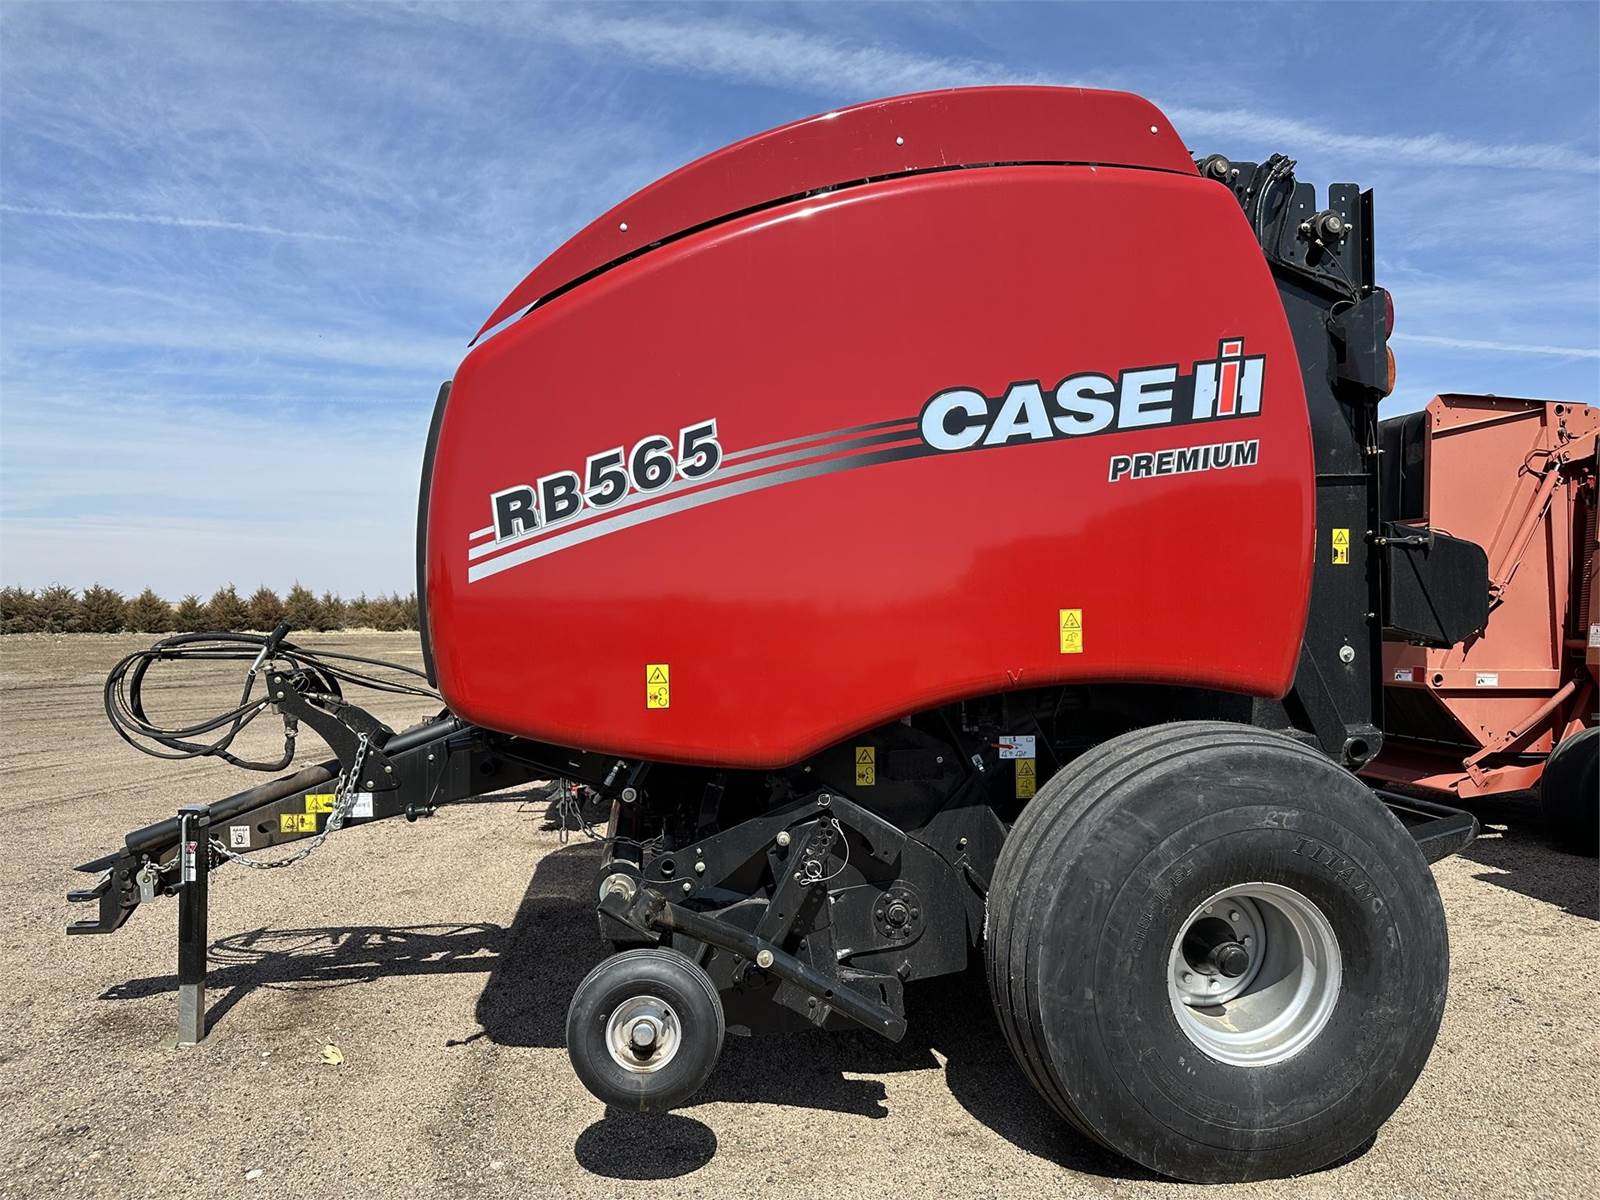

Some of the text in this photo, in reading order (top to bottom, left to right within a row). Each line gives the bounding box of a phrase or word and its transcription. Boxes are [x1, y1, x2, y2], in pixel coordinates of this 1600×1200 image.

[490, 418, 723, 544] RB565
[1108, 439, 1260, 483] PREMIUM
[1289, 836, 1379, 904] TITAN
